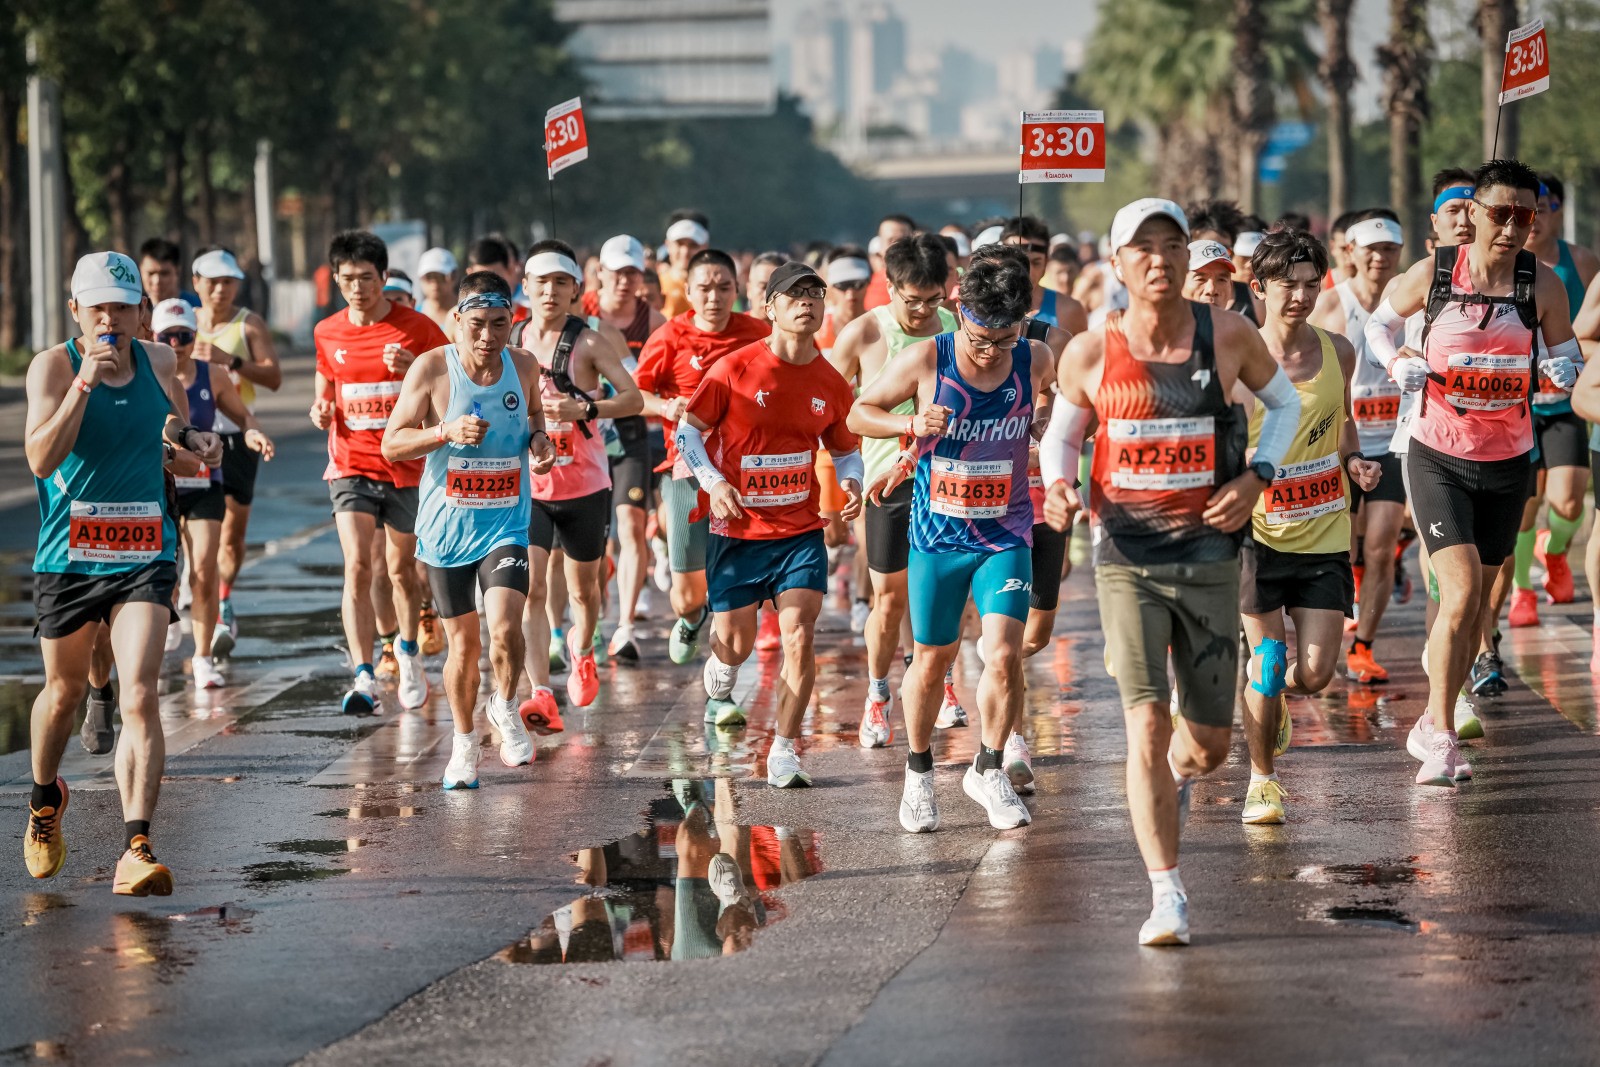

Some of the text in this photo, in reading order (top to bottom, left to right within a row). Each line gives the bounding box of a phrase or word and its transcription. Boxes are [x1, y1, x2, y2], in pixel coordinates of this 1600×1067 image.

[1510, 36, 1544, 76] 3:30
[1030, 127, 1094, 157] 3:30
[1452, 375, 1523, 392] A10062
[348, 400, 398, 414] A1226
[933, 416, 1030, 442] ARATHON
[1118, 444, 1207, 466] A12505
[452, 477, 515, 492] A12225
[747, 472, 807, 489] A10440
[937, 480, 1006, 499] A12633
[1271, 476, 1339, 505] A11809
[76, 525, 156, 543] A10203
